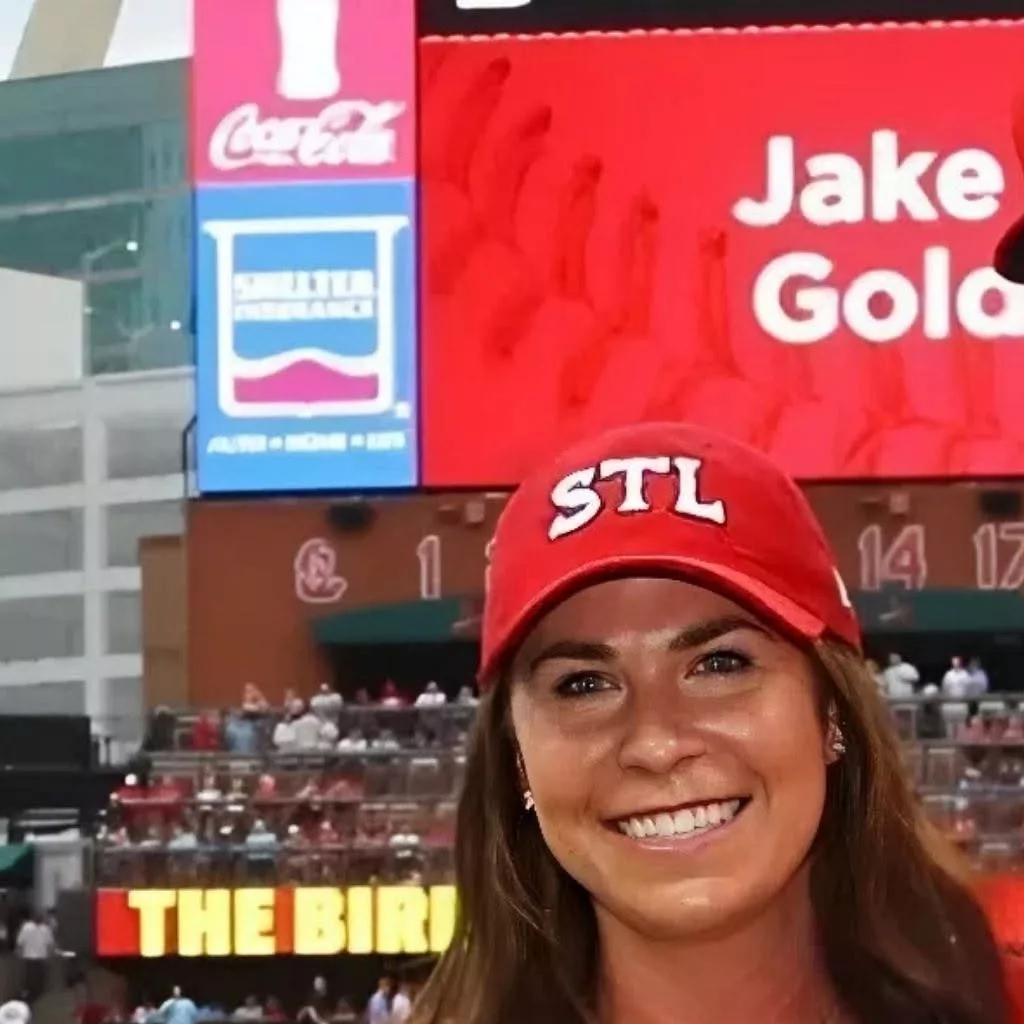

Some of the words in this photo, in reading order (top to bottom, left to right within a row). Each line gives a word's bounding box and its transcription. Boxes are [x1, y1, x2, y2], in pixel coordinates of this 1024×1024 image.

[732, 129, 1006, 226] Jake
[548, 456, 726, 541] STL
[416, 534, 442, 600] 1
[859, 524, 927, 591] 14
[127, 888, 276, 957] THE
